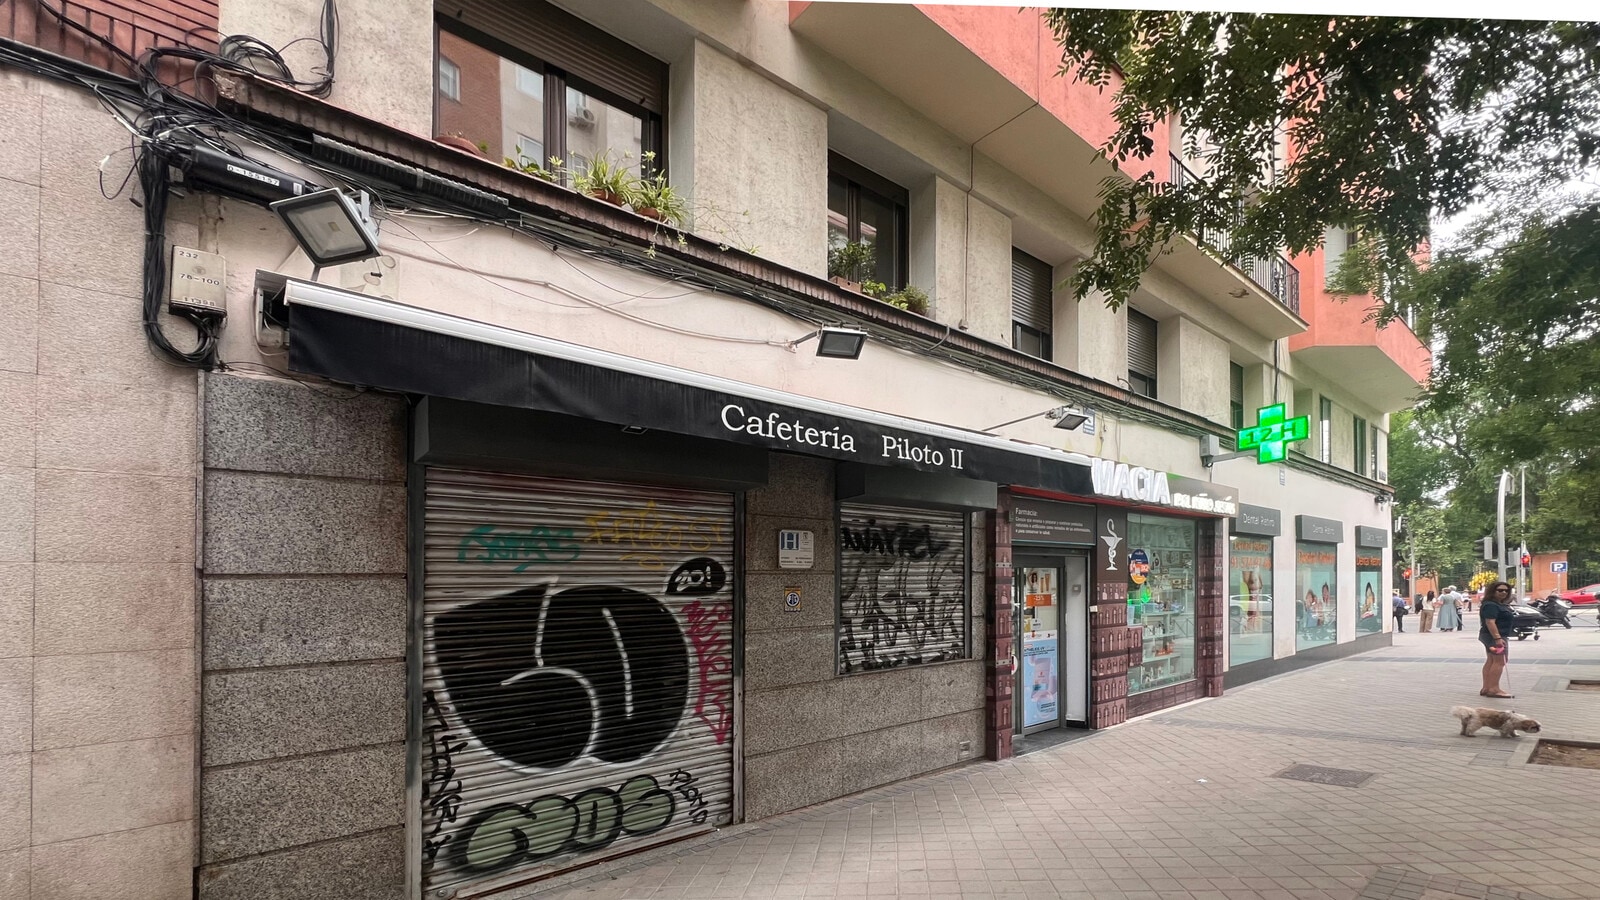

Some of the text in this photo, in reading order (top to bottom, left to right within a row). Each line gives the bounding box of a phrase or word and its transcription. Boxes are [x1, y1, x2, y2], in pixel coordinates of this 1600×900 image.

[179, 250, 198, 259] 232
[721, 404, 963, 470] Cafetería Piloto II
[1554, 563, 1564, 572] P
